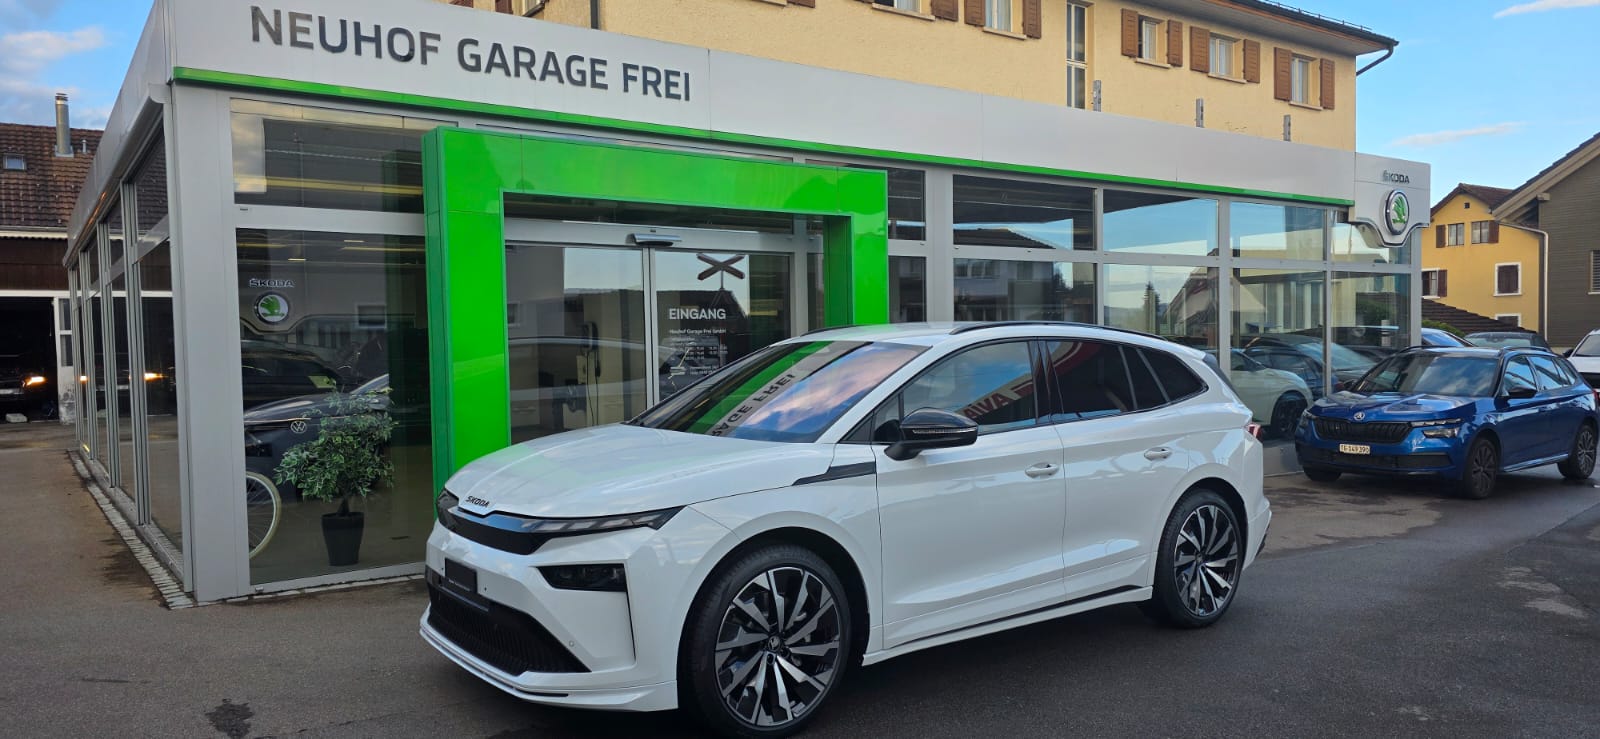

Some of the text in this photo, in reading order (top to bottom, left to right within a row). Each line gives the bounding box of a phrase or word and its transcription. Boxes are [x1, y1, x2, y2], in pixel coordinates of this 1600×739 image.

[250, 5, 692, 102] NEUHOF GARAGE FREI
[668, 308, 727, 320] EINGANG
[687, 328, 703, 336] Garage
